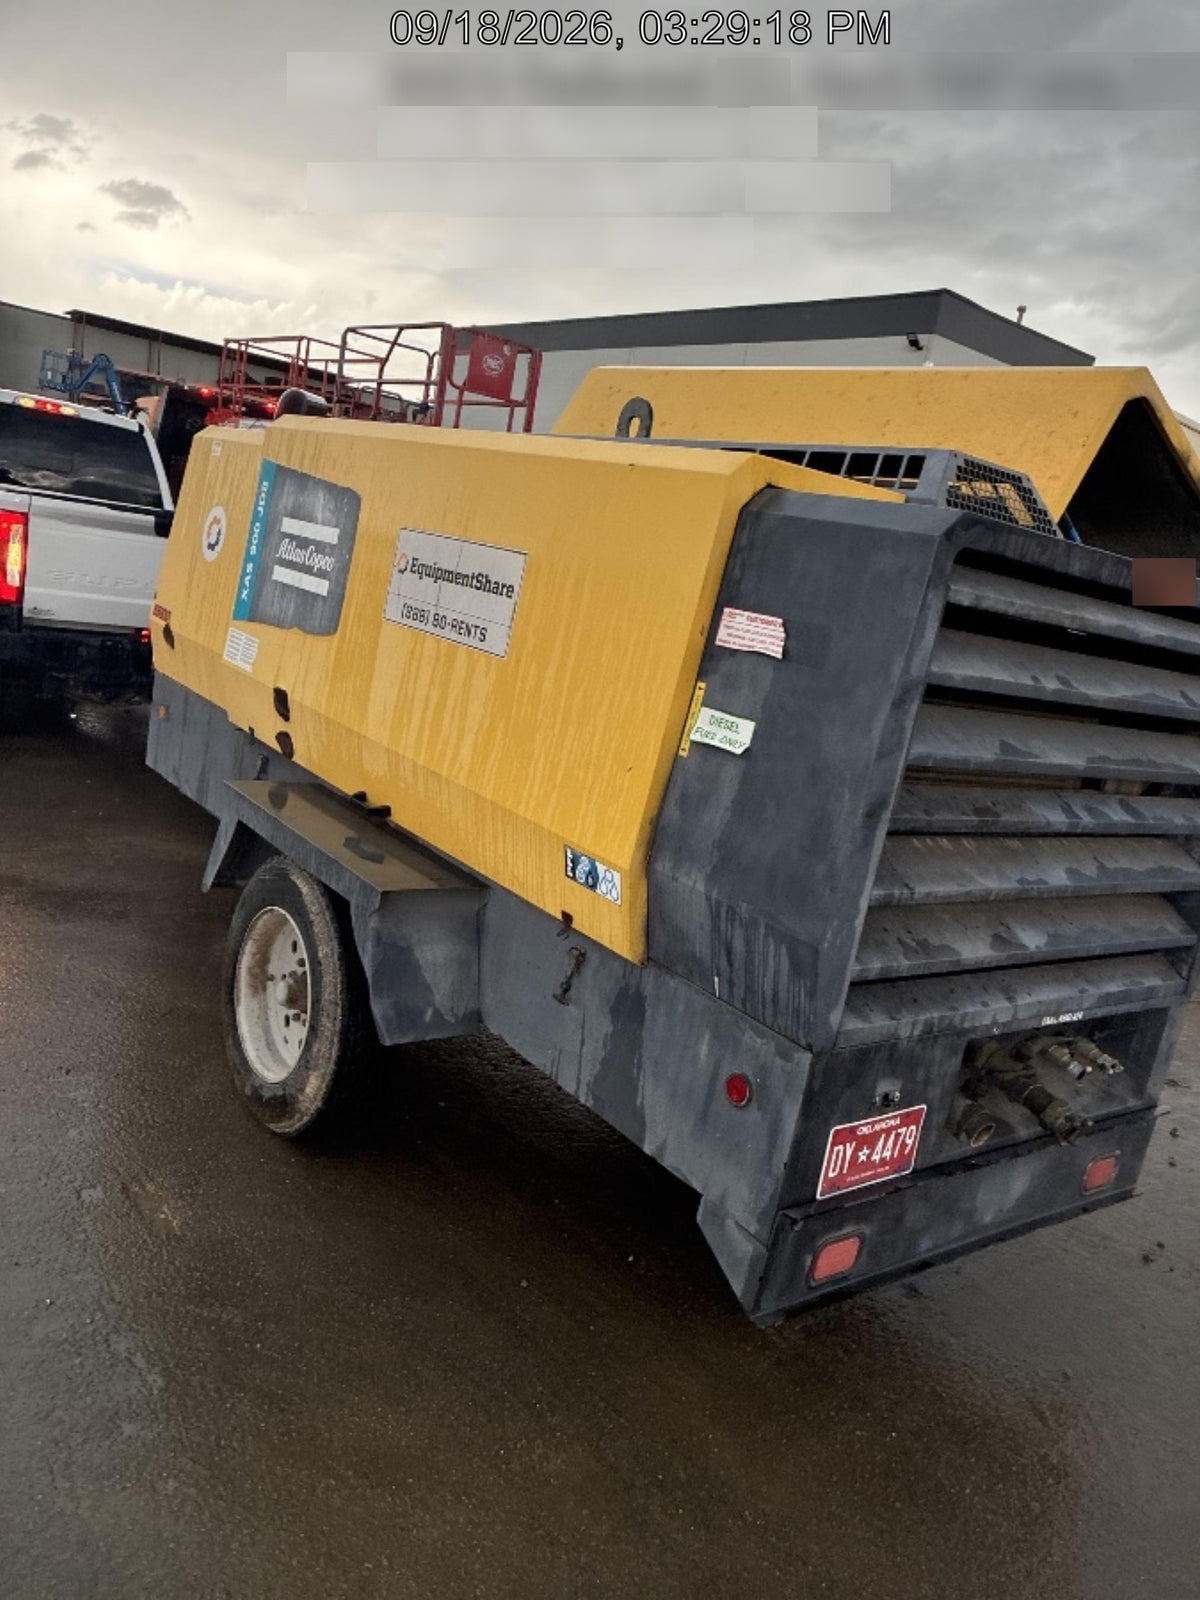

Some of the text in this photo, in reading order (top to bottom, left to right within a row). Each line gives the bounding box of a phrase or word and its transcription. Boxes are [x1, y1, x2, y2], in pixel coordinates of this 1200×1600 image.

[241, 562, 254, 600] XAS
[409, 556, 515, 600] EquipmentShare
[708, 714, 741, 735] DIESEL
[857, 1117, 901, 1135] OKLAHOMA
[828, 1141, 856, 1178] DY
[871, 1125, 917, 1163] 4479
